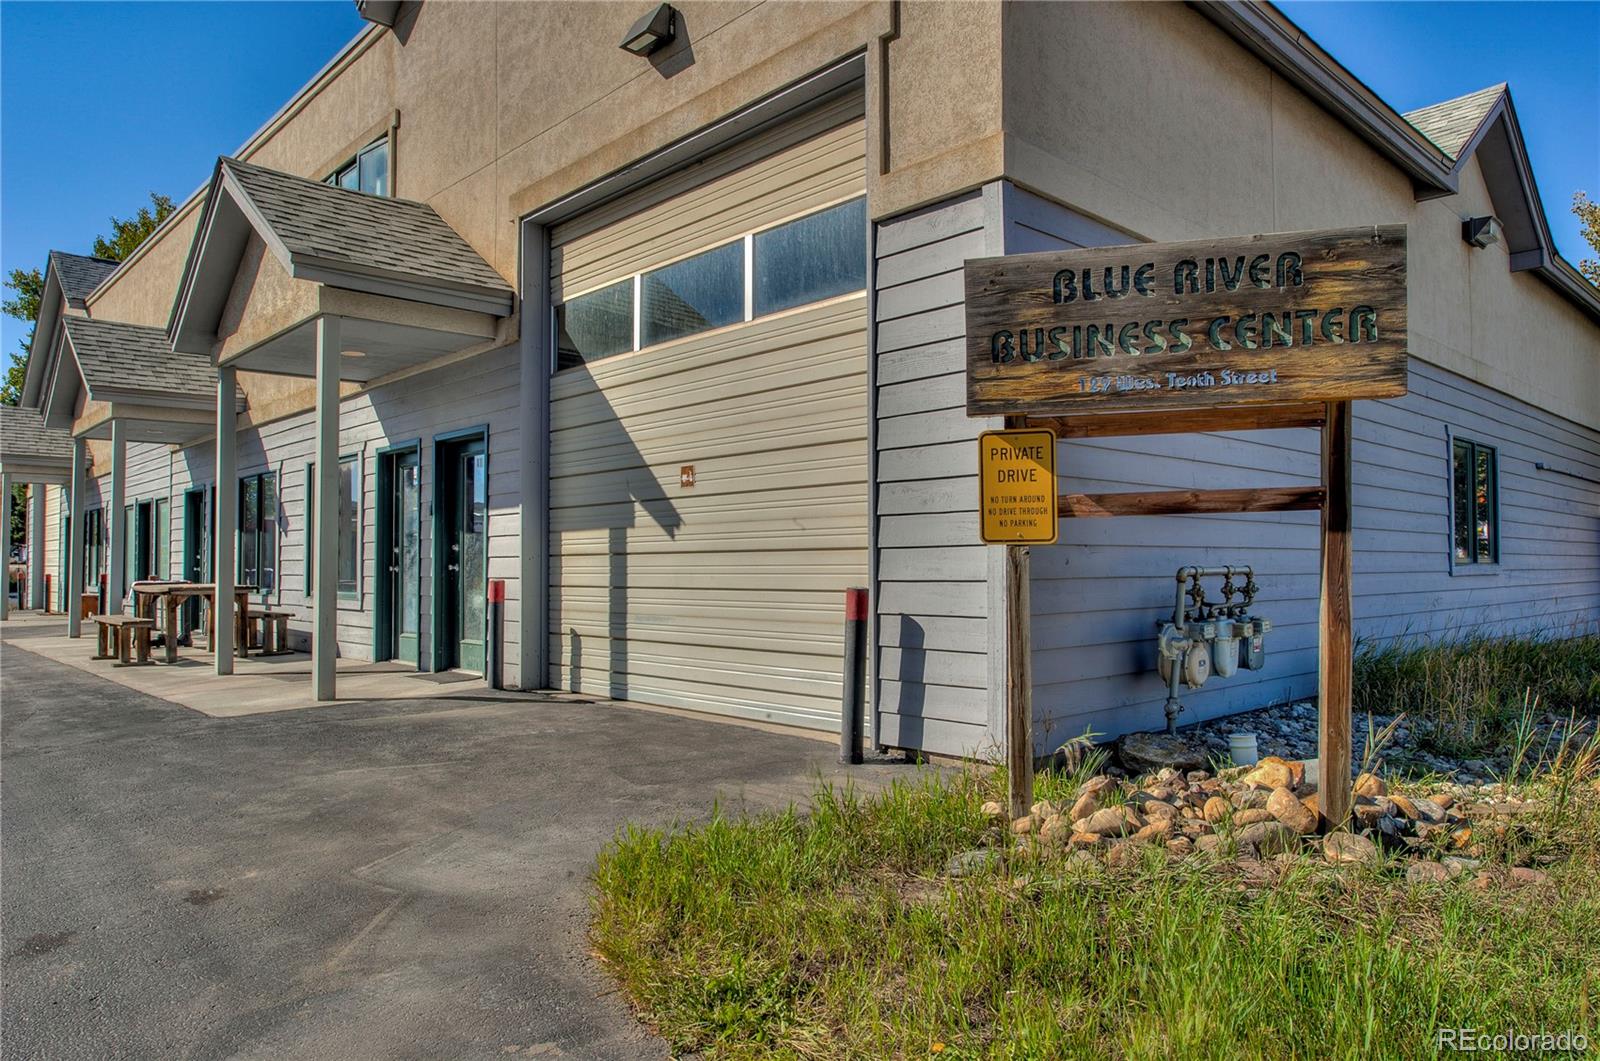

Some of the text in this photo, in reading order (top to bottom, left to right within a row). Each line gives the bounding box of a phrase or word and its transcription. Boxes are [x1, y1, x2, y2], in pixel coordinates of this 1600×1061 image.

[1052, 250, 1305, 305] BLUE RIVER
[990, 304, 1380, 364] BUSINESS CENTER
[1166, 370, 1216, 390] Tenth
[1220, 367, 1278, 386] Street
[990, 446, 1044, 461] PRIVATE
[997, 468, 1038, 483] DRIVE
[990, 494, 1046, 504] NO TURN AROUND
[988, 506, 1048, 516] NO DRIVE THROUGH
[999, 519, 1038, 528] NO PARKING
